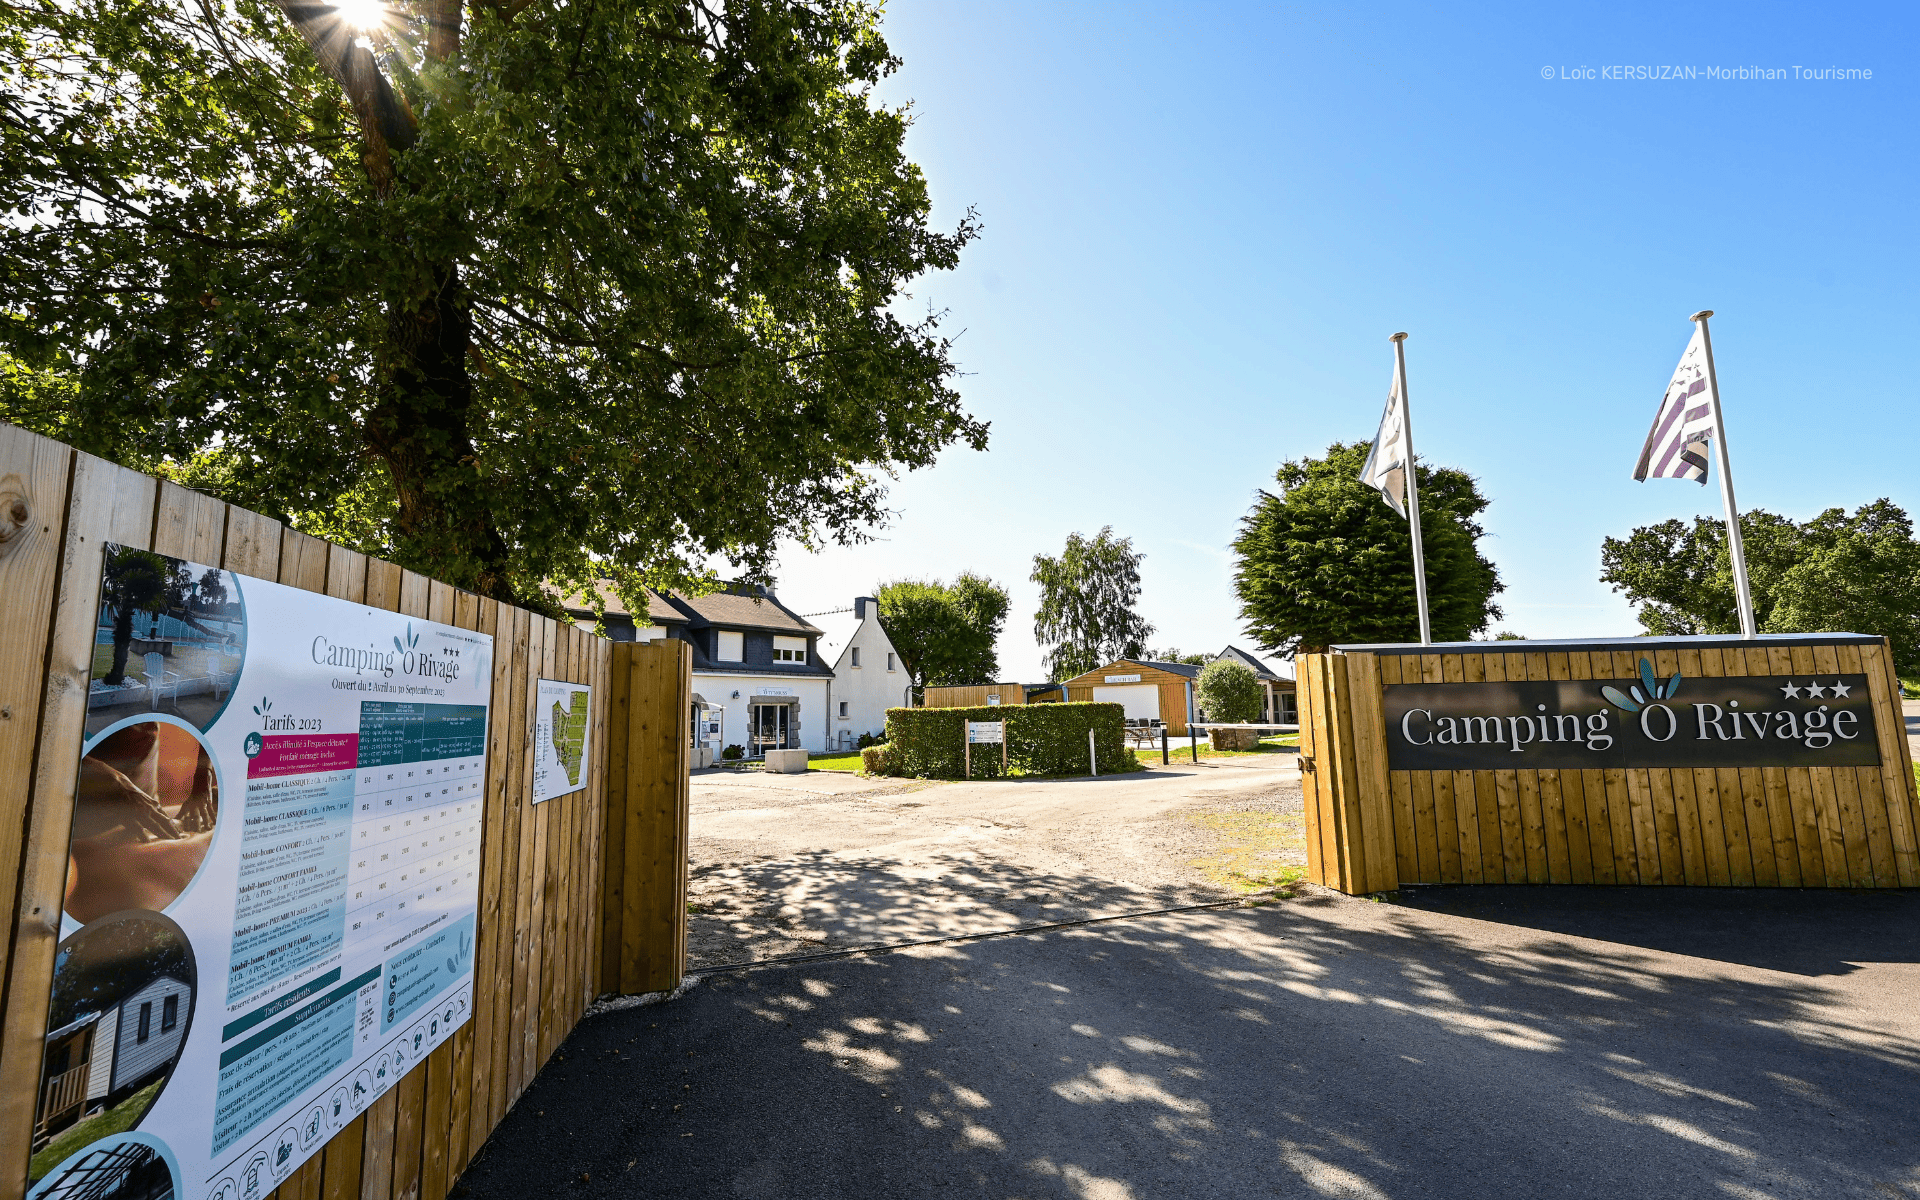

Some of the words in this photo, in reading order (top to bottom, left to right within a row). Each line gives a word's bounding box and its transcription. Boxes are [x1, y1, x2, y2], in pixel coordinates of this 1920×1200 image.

[311, 635, 394, 678] Camping
[418, 653, 460, 683] Rivage
[331, 677, 357, 692] Ouvert
[357, 679, 368, 692] du
[372, 681, 389, 694] Avril
[389, 684, 398, 693] au
[262, 714, 298, 731] Tarifs
[298, 718, 322, 734] 2023
[1401, 703, 1613, 752] Camping
[1692, 700, 1860, 750] Rivage
[247, 781, 280, 792] Mobil-home
[244, 814, 277, 826] Mobil-home
[278, 809, 307, 821] CLASSIQUE
[241, 846, 274, 861] Mobil-home
[275, 840, 301, 852] CONFORT
[238, 878, 272, 895] Mobil-home
[273, 871, 298, 884] CONFORT
[234, 920, 268, 939] Mobil-home
[230, 953, 265, 974] Mobil-home
[266, 941, 292, 958] PREMIUM
[253, 961, 266, 972] Pers.
[220, 1067, 234, 1081] Taxe
[235, 1062, 242, 1072] de
[218, 1083, 233, 1099] Frais
[234, 1078, 242, 1089] de
[214, 1121, 237, 1143] Visiteur
